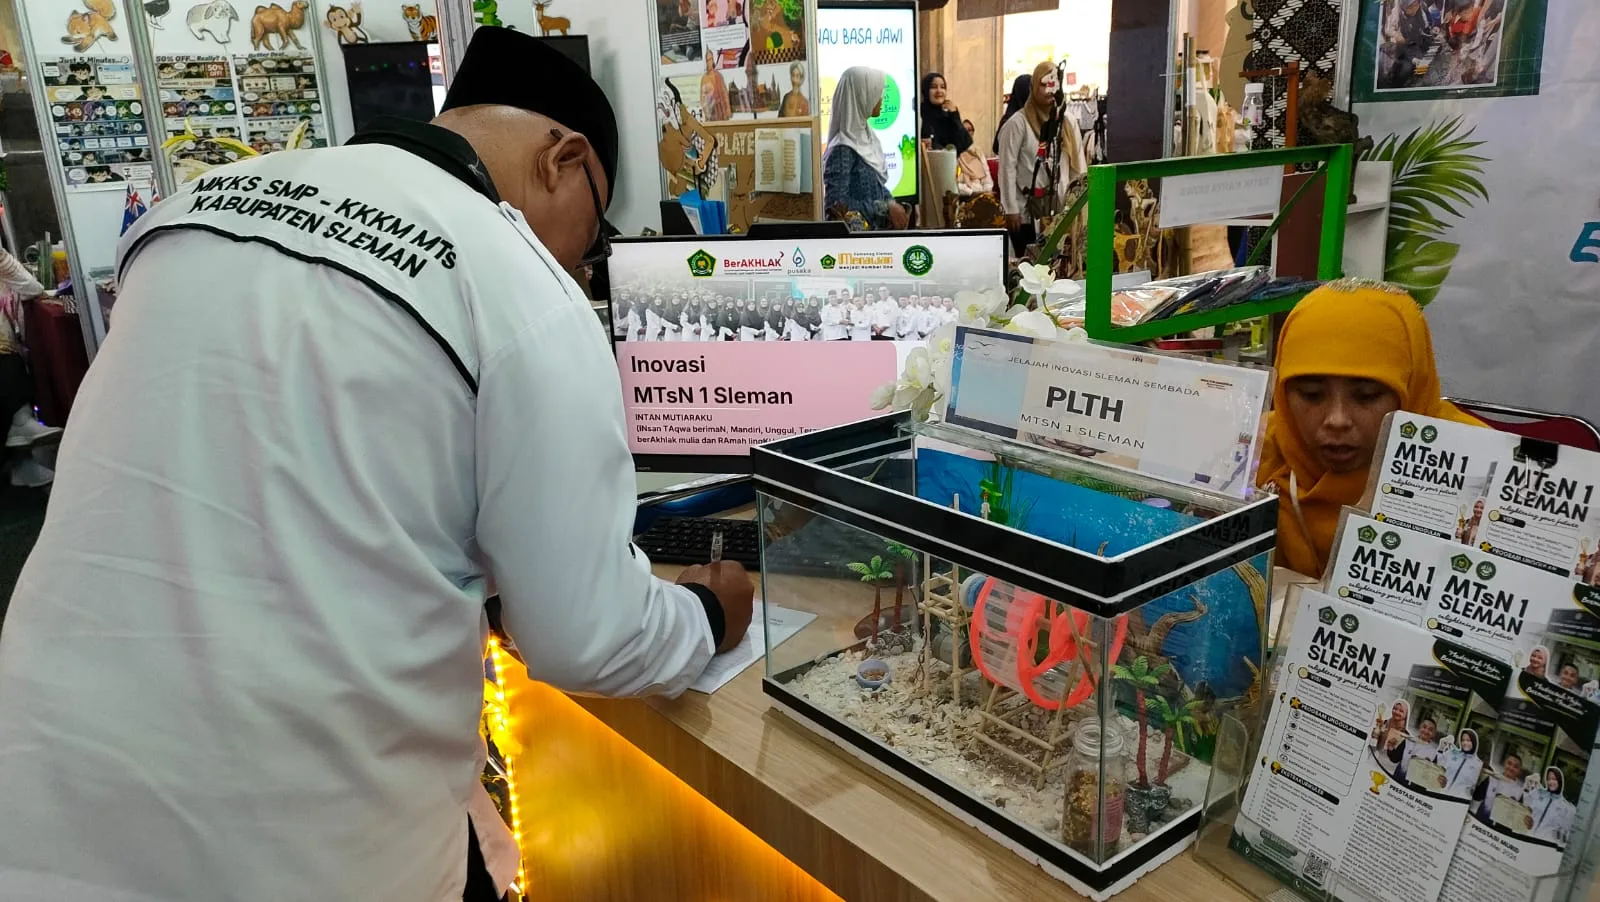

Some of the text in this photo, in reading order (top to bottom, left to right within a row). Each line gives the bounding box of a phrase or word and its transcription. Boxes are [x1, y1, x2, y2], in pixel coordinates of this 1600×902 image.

[843, 28, 872, 45] BASA
[876, 28, 902, 45] JAWI
[207, 64, 223, 72] 50%
[716, 131, 755, 155] PLATE
[188, 195, 427, 278] KABUPATEN SLEMAN
[192, 176, 262, 194] MKKS
[263, 179, 318, 201] SMP
[335, 198, 413, 240] KKKM
[413, 229, 457, 270] MTs
[724, 258, 782, 269] BerAKHLAK
[631, 355, 706, 374] Inovasi
[1007, 356, 1049, 369] JELAJAH
[1051, 362, 1093, 378] INOVASI
[1095, 371, 1140, 387] SLEMAN
[1143, 381, 1200, 397] SEMBADA
[634, 386, 793, 405] MTsN 1 Sleman
[1046, 386, 1124, 423] PLTH
[635, 413, 713, 422] INTAN MUTIARAKU
[663, 425, 691, 434] TAqwa
[730, 426, 763, 435] Mandiri,
[765, 427, 797, 436] Unggul,
[1020, 414, 1145, 449] MTSN 1 SLEMAN
[637, 436, 677, 444] berAkhlak
[718, 437, 747, 445] RAmah
[1394, 441, 1469, 473] MTsN 1
[1391, 460, 1465, 490] SLEMAN
[1504, 465, 1594, 504] MTsN 1
[1500, 485, 1589, 522] SLEMAN
[1348, 563, 1431, 600] SLEMAN
[1352, 545, 1436, 584] MTsN 1
[1439, 593, 1523, 635] SLEMAN
[1444, 575, 1514, 613] MTsN
[1518, 599, 1529, 618] 1
[1308, 645, 1386, 688] SLEMAN
[1312, 626, 1391, 672] MTsN 1
